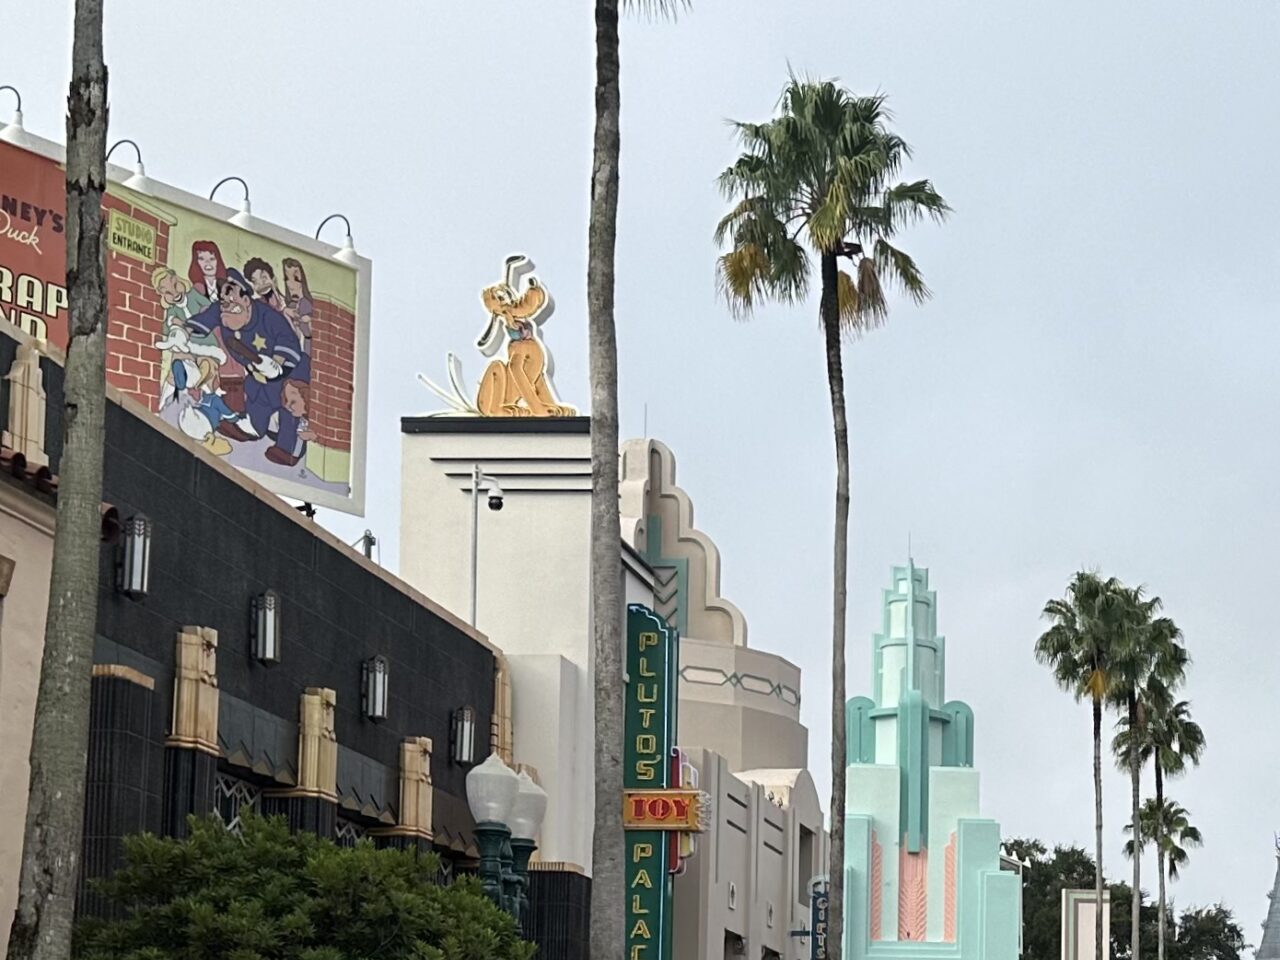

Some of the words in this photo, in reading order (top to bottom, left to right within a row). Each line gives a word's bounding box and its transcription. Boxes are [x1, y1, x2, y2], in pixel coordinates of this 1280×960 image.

[115, 216, 153, 243] STUDIO
[112, 232, 152, 259] ENTRANCE
[636, 632, 662, 780] PLUTO'S
[630, 797, 690, 821] TOY
